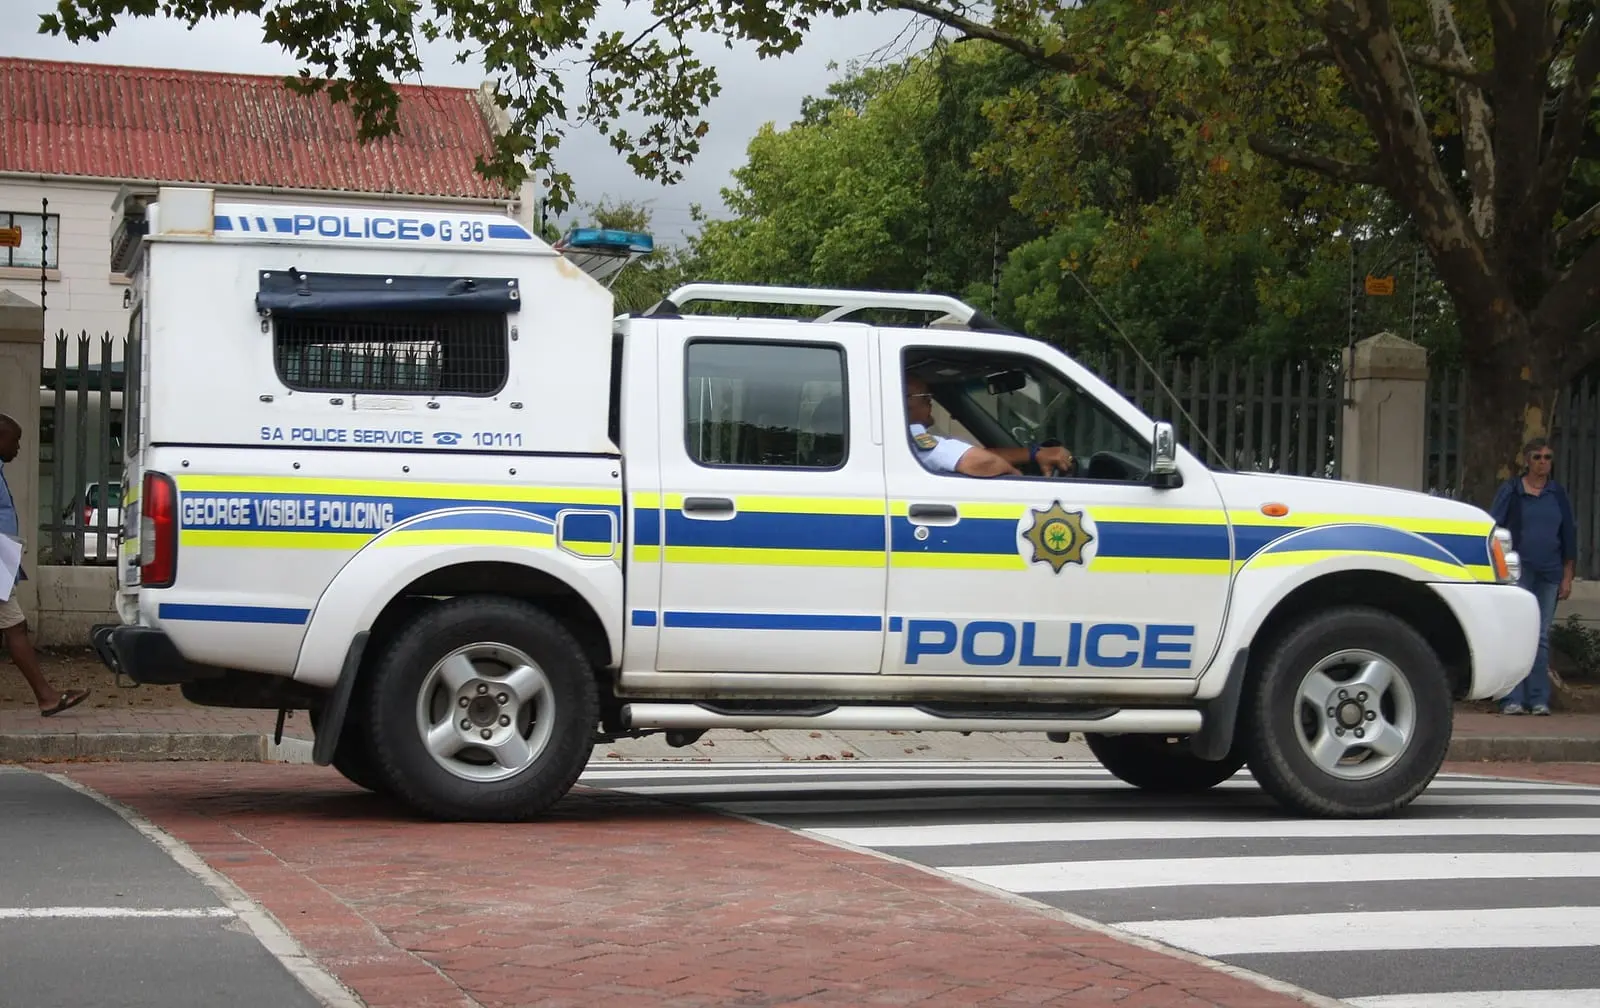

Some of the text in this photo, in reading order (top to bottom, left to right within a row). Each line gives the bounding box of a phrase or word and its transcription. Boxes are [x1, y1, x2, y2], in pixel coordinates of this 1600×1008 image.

[294, 214, 484, 243] POLICE G 36
[260, 426, 523, 447] SA POLICE SERVICE 10111
[182, 498, 394, 530] GEORGE VISIBLE POLICING
[904, 619, 1195, 669] POLICE
